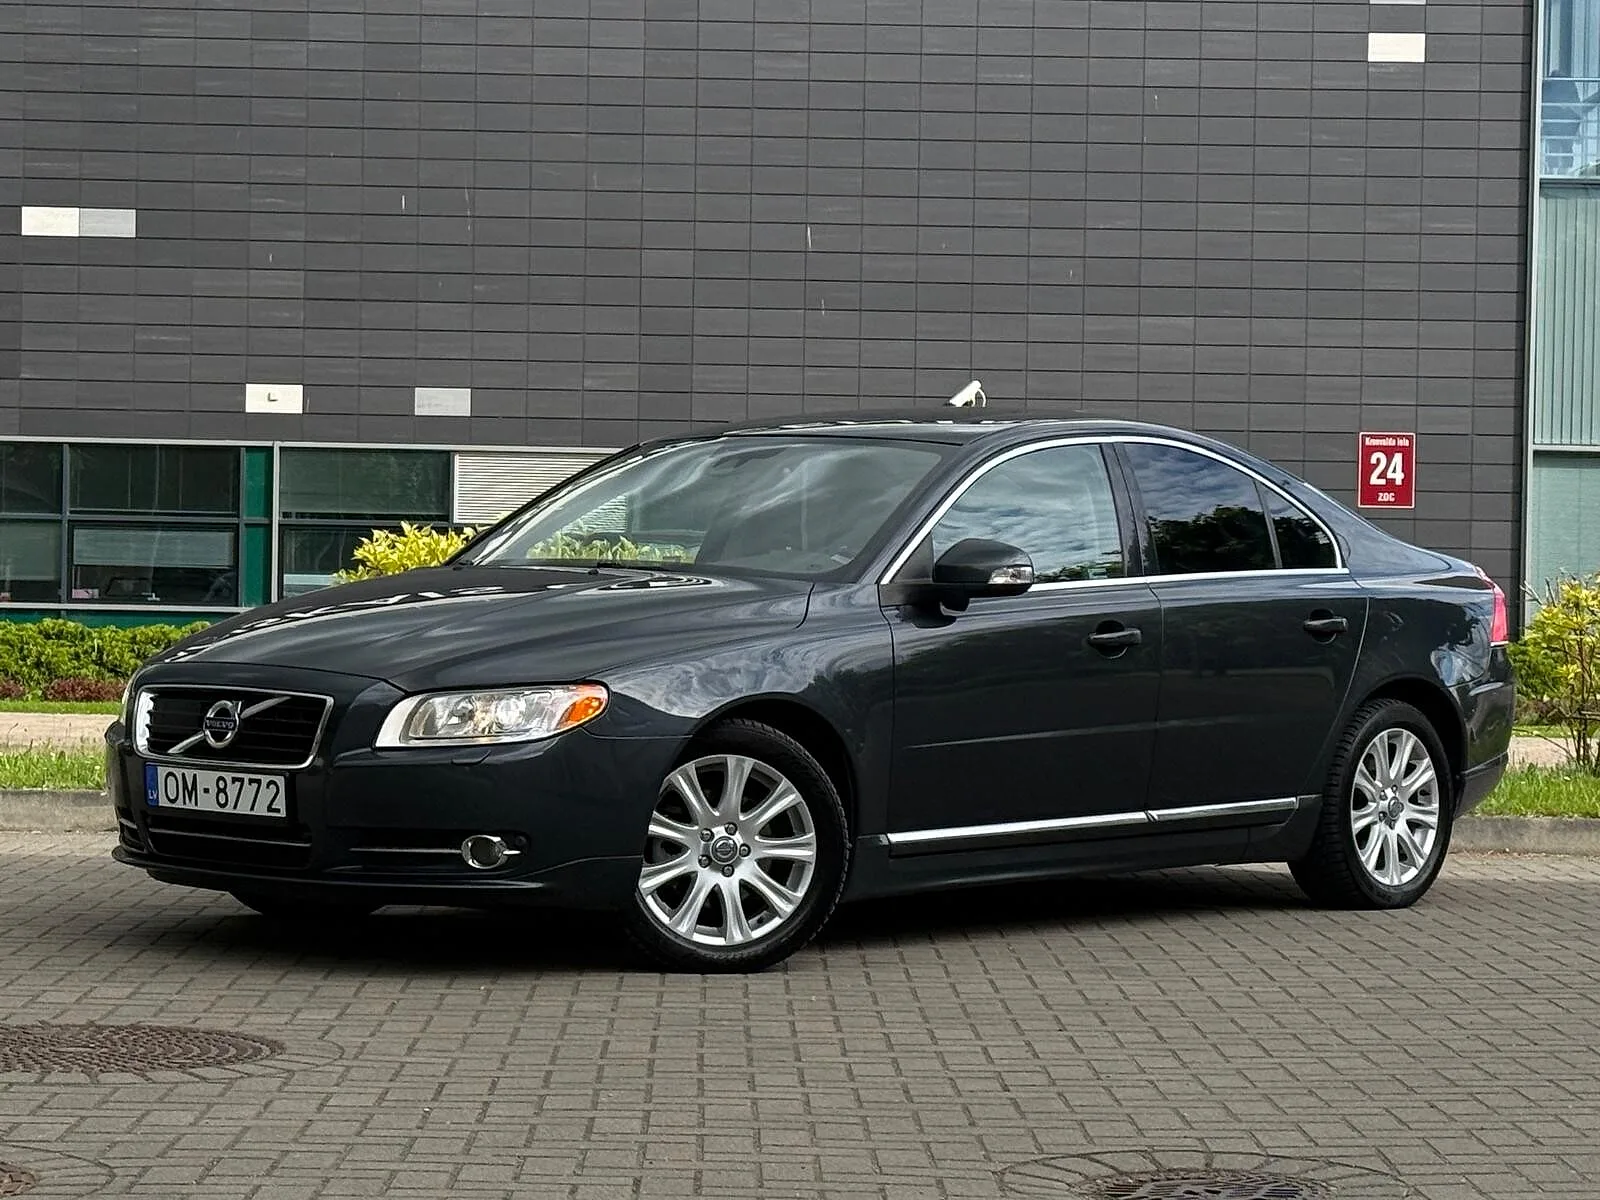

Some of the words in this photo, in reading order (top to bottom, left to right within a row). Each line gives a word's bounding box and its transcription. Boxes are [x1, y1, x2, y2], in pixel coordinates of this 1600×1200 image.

[1369, 451, 1405, 485] 24
[206, 719, 235, 729] VOLVO
[148, 789, 158, 800] LV
[164, 771, 281, 813] OM-8772
